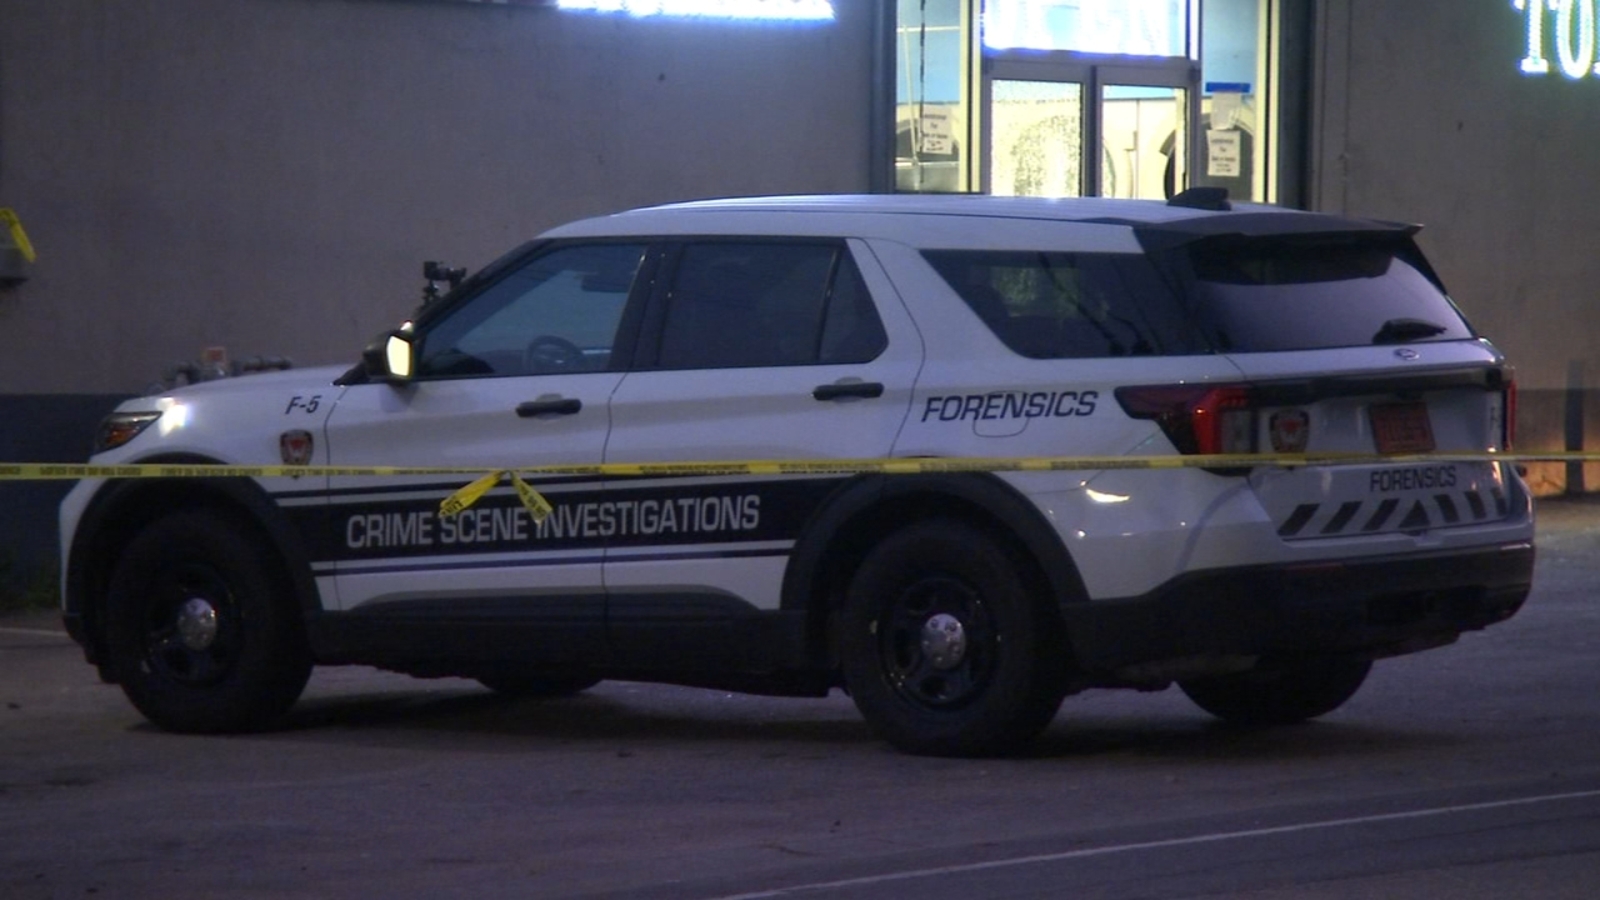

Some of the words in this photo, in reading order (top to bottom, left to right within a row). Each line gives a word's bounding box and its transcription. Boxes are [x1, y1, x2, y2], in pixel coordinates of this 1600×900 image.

[1512, 0, 1600, 79] TO
[285, 395, 322, 415] F-5
[921, 391, 1099, 422] FORENSICS
[1369, 465, 1456, 492] FORENSICS
[346, 512, 433, 549] CRIME
[440, 507, 528, 543] SCENE
